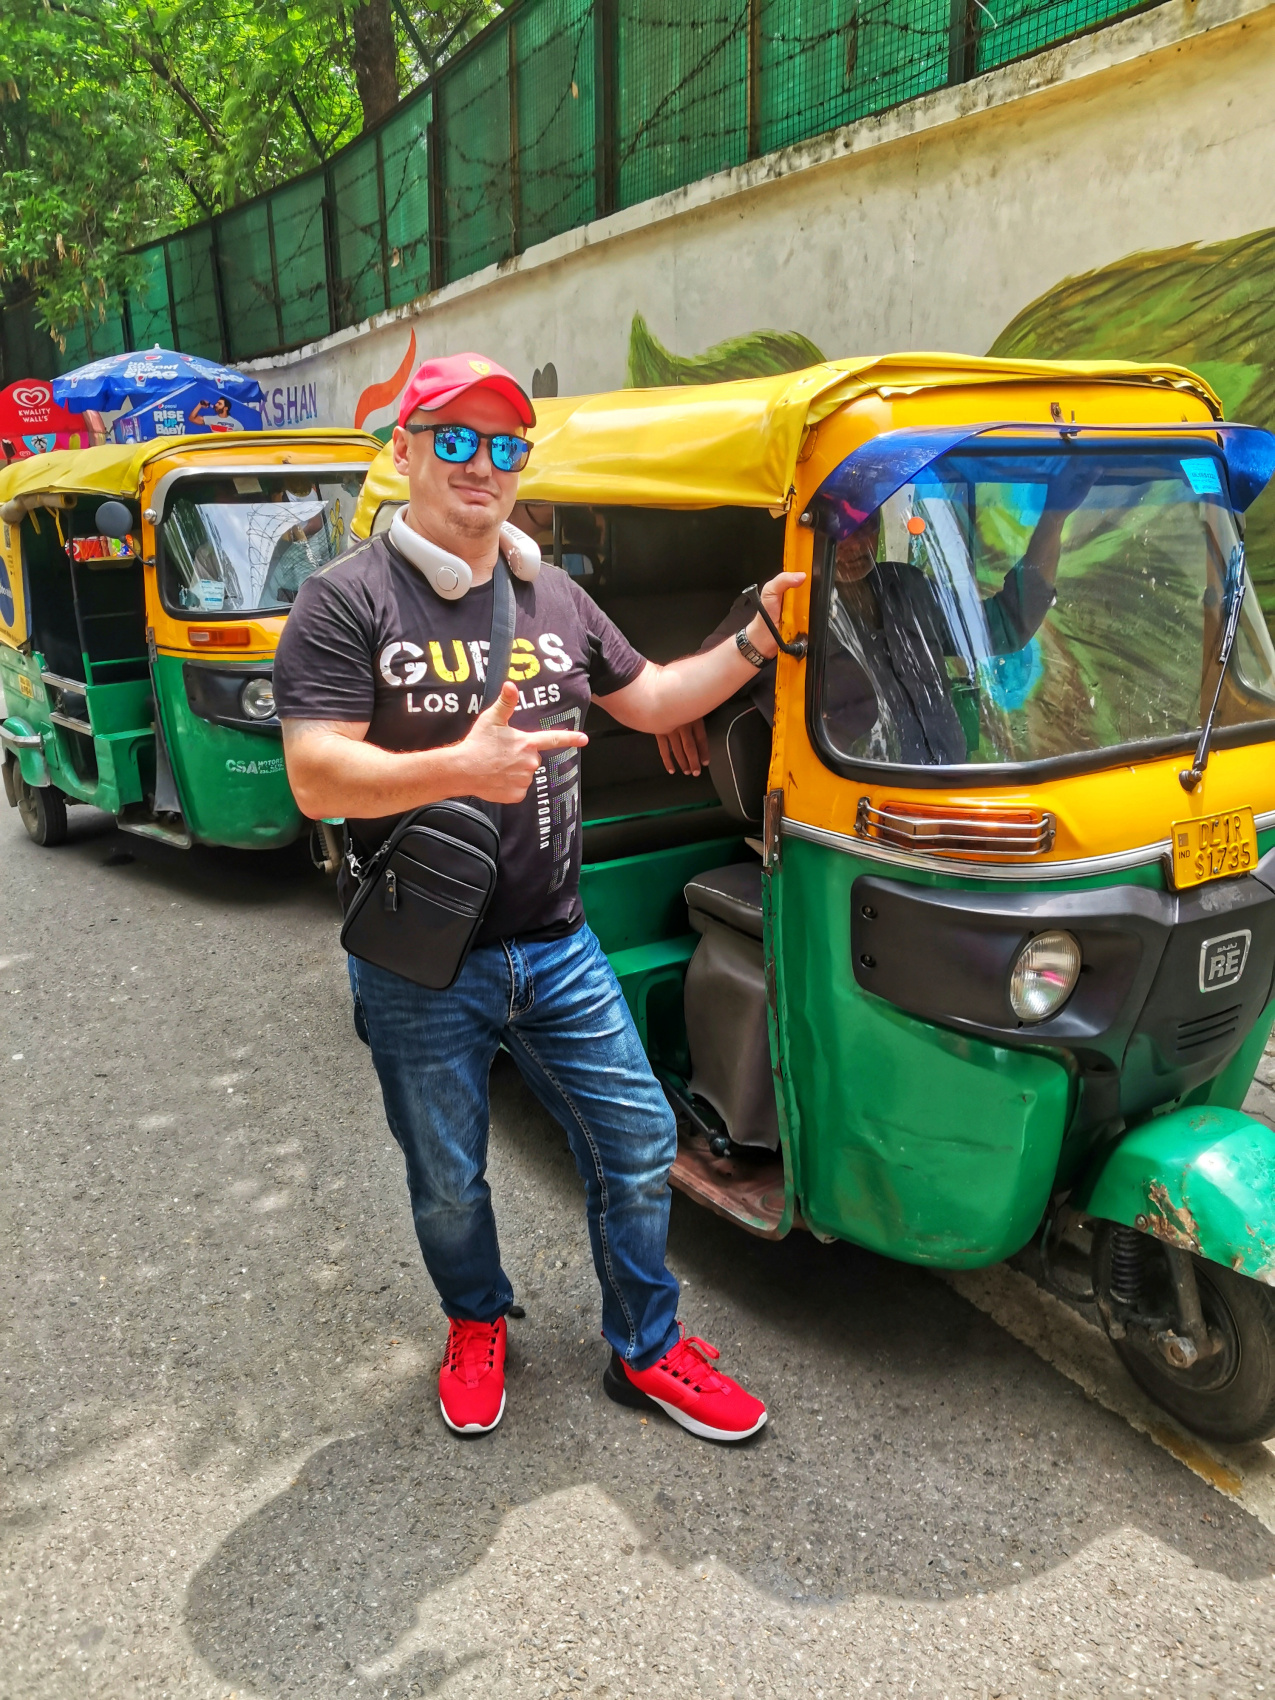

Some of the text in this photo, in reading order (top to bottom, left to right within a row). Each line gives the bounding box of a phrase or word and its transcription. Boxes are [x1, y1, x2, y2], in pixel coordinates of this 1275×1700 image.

[18, 408, 51, 416] KWALITY
[153, 410, 185, 422] RISE
[155, 423, 186, 436] BABY!
[164, 418, 178, 428] UP
[406, 691, 460, 714] LOS
[225, 759, 259, 775] CSA
[534, 765, 552, 850] CALIFORNIA
[1178, 849, 1191, 860] IND
[1208, 948, 1241, 981] RE
